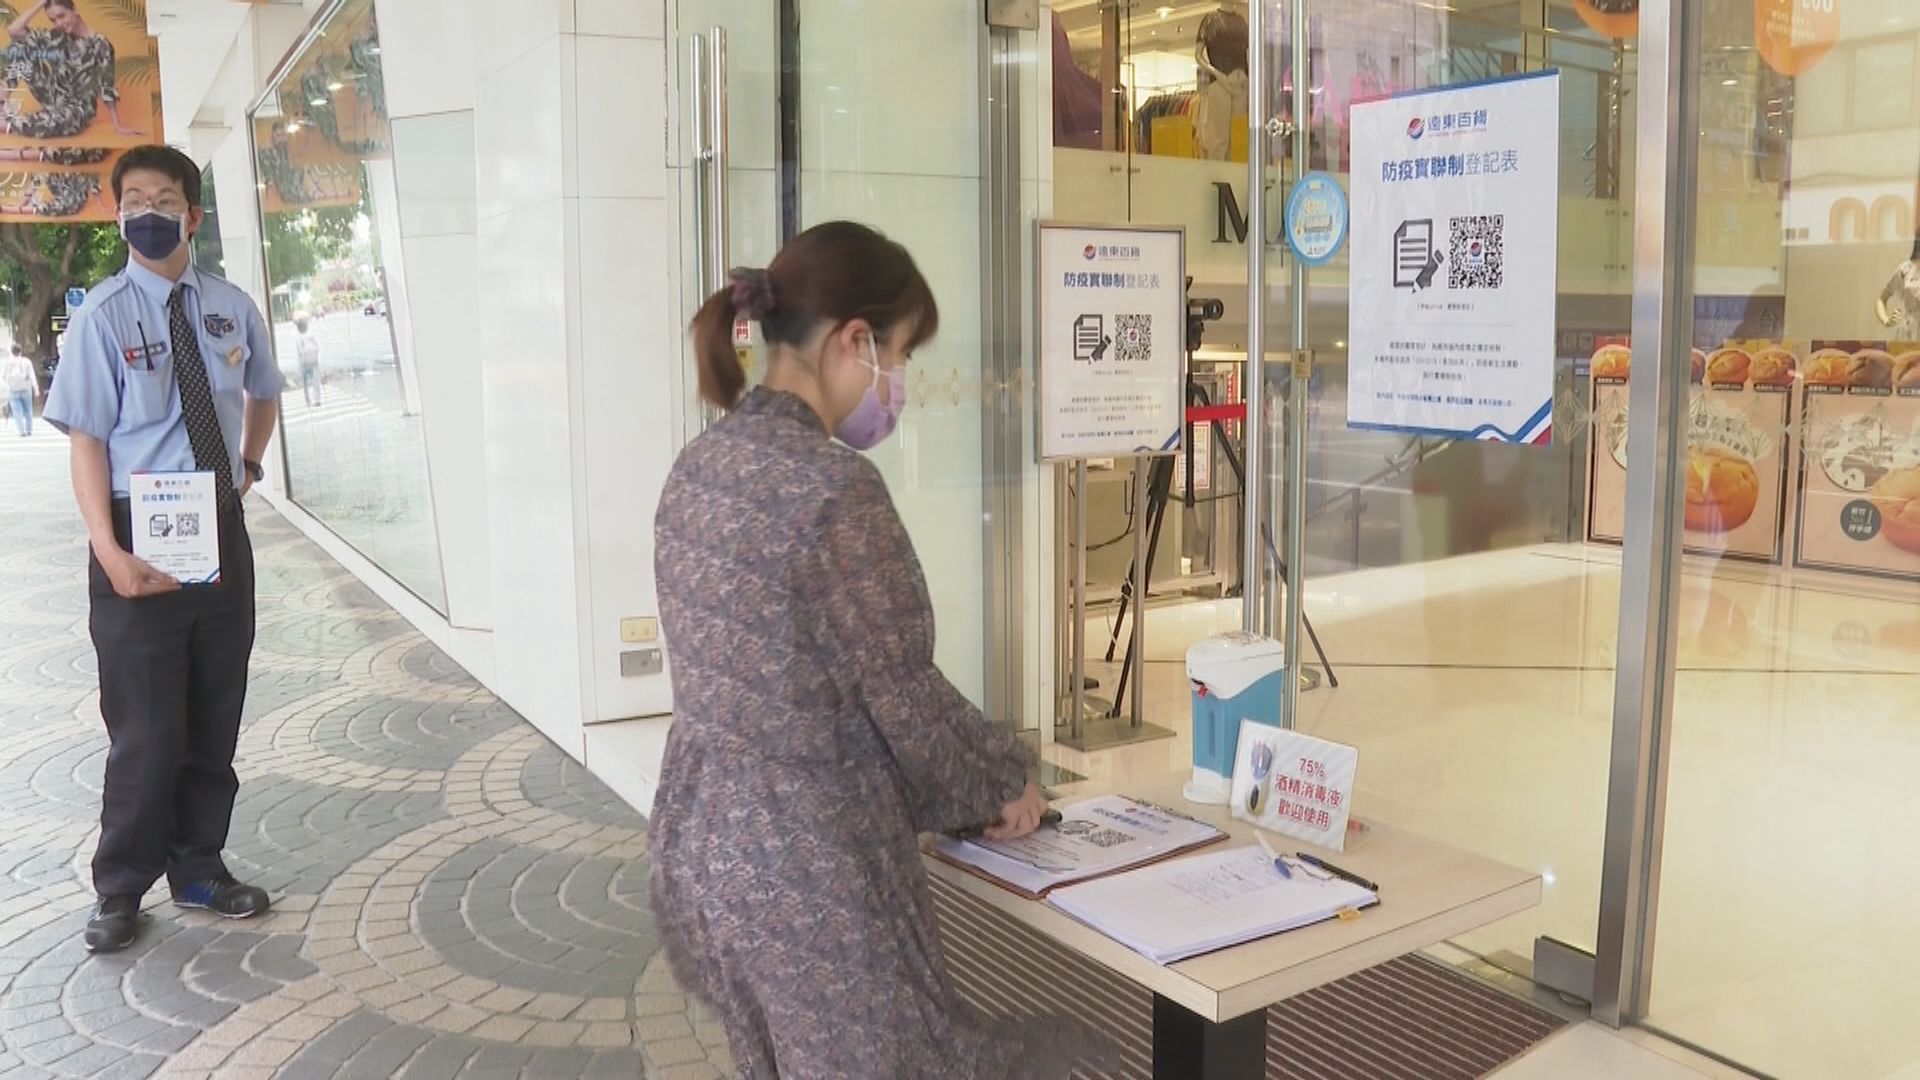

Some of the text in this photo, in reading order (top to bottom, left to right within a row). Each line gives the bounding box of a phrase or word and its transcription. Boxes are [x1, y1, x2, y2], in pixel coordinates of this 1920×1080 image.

[1427, 109, 1488, 132] 遠東百貨
[1382, 149, 1518, 183] 防疫實聯制登記表
[1063, 271, 1161, 289] 防疫實聯制登記表
[1299, 758, 1326, 778] 75%
[1275, 774, 1342, 808] 酒精消毒液
[1278, 798, 1329, 828] 歡迎使用
